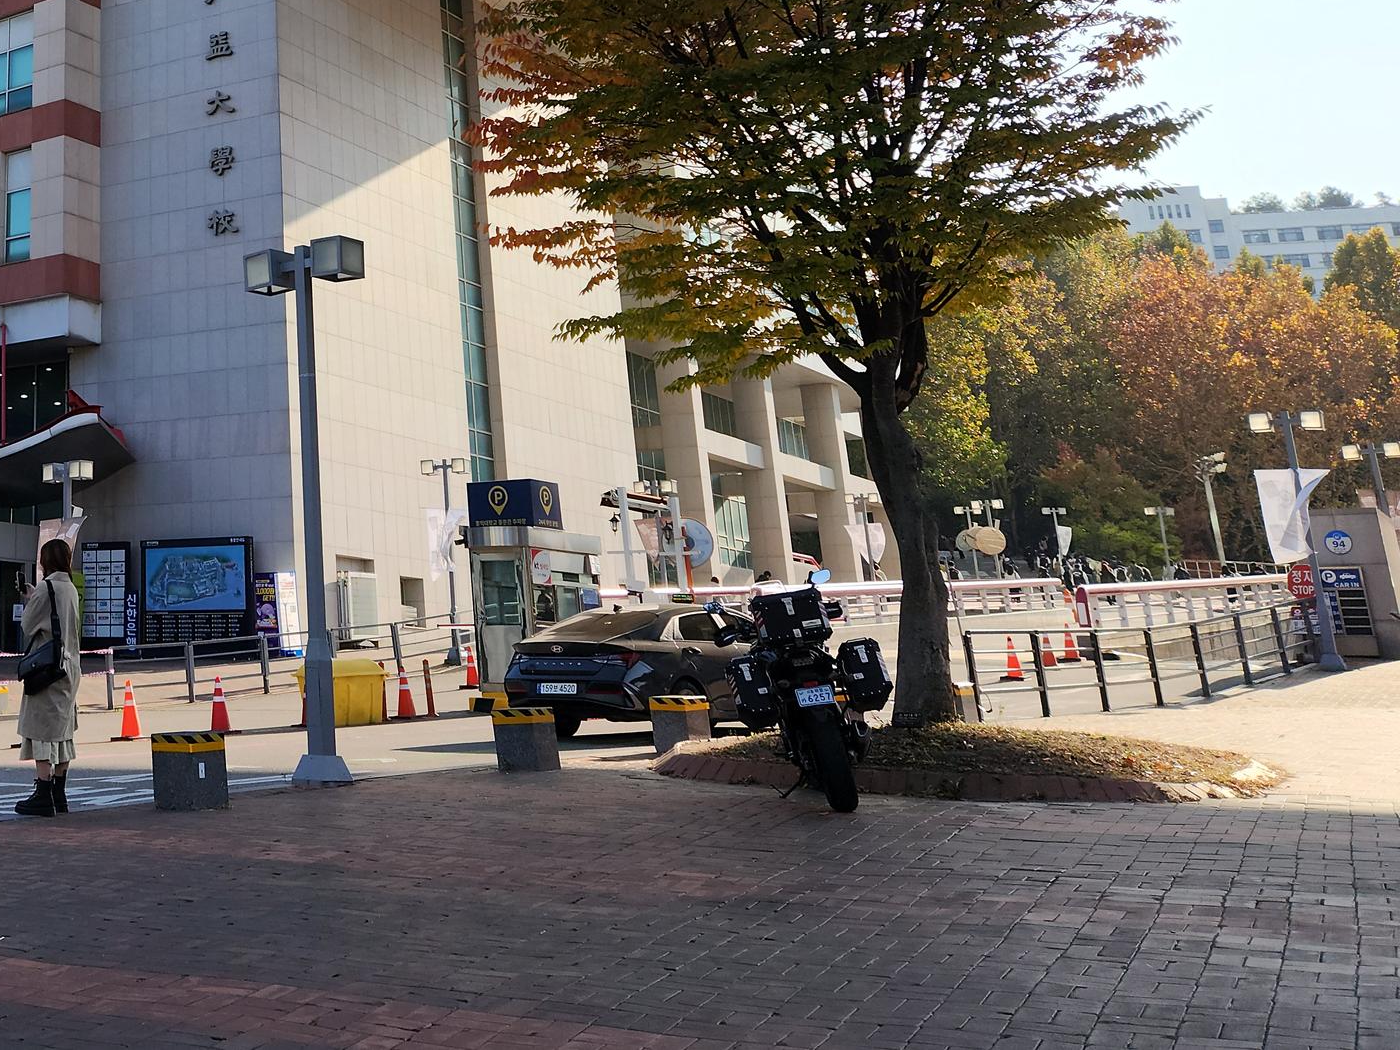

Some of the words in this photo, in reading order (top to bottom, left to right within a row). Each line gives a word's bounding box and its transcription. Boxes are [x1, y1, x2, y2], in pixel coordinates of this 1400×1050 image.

[493, 491, 503, 504] P
[543, 491, 549, 504] P
[1332, 540, 1346, 548] 94
[1324, 572, 1333, 581] P
[1292, 585, 1315, 595] STOP
[126, 593, 138, 651] 신한은행
[559, 684, 576, 693] 4520
[808, 692, 831, 703] 6257
